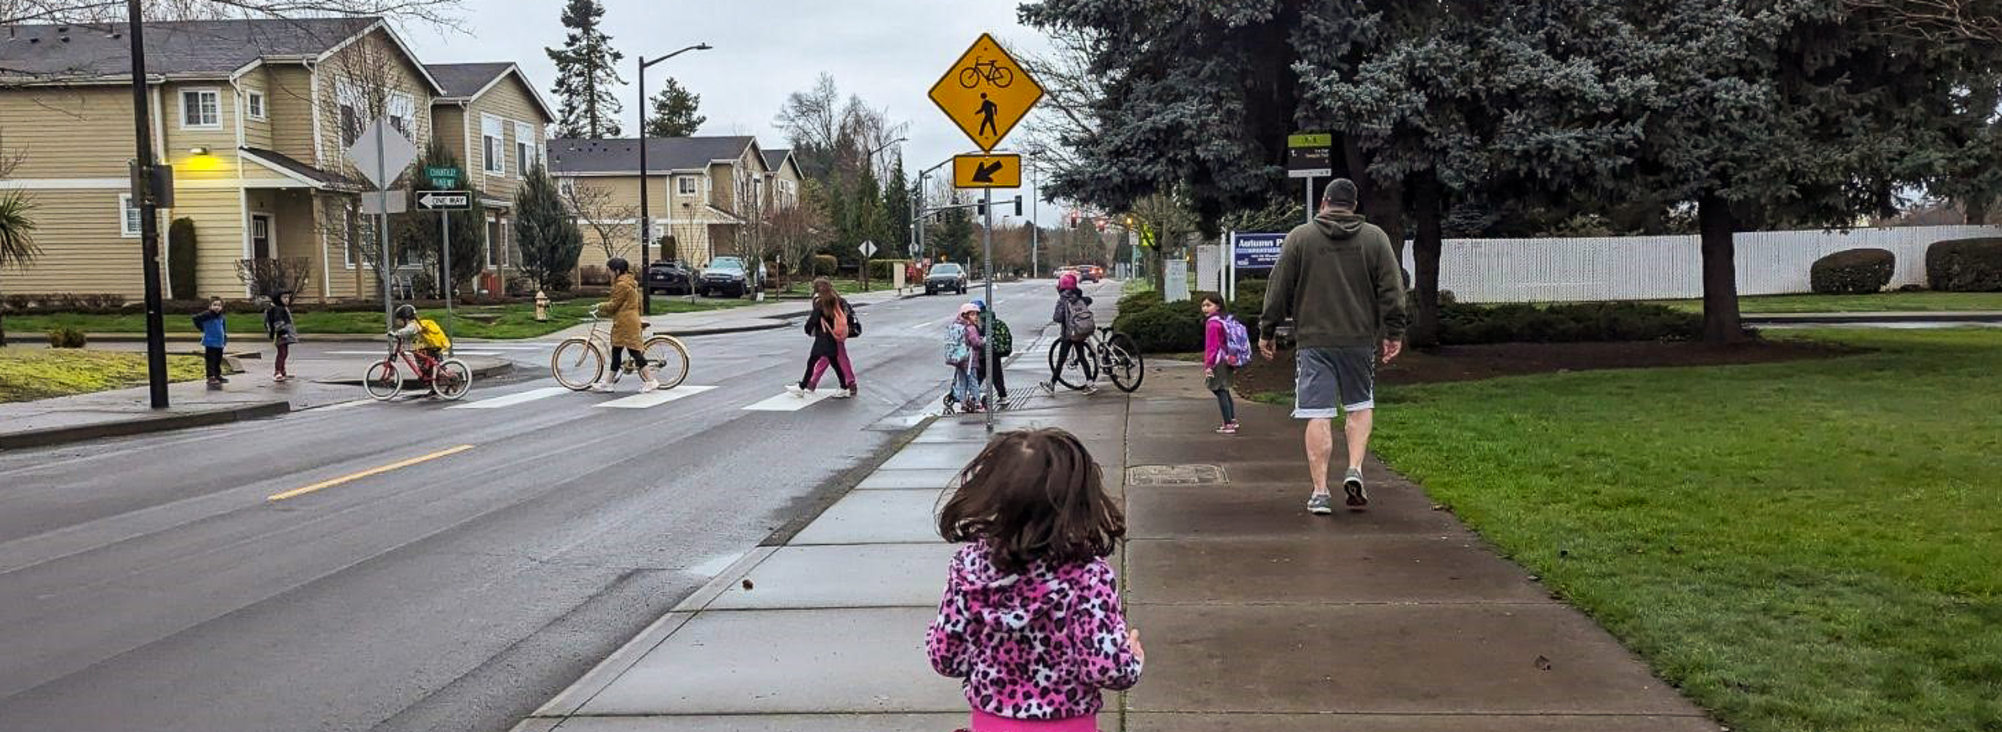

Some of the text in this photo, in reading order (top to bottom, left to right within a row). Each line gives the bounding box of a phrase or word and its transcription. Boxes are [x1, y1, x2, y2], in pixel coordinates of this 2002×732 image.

[432, 195, 464, 204] ONE WAY
[1238, 239, 1274, 247] Autumn
